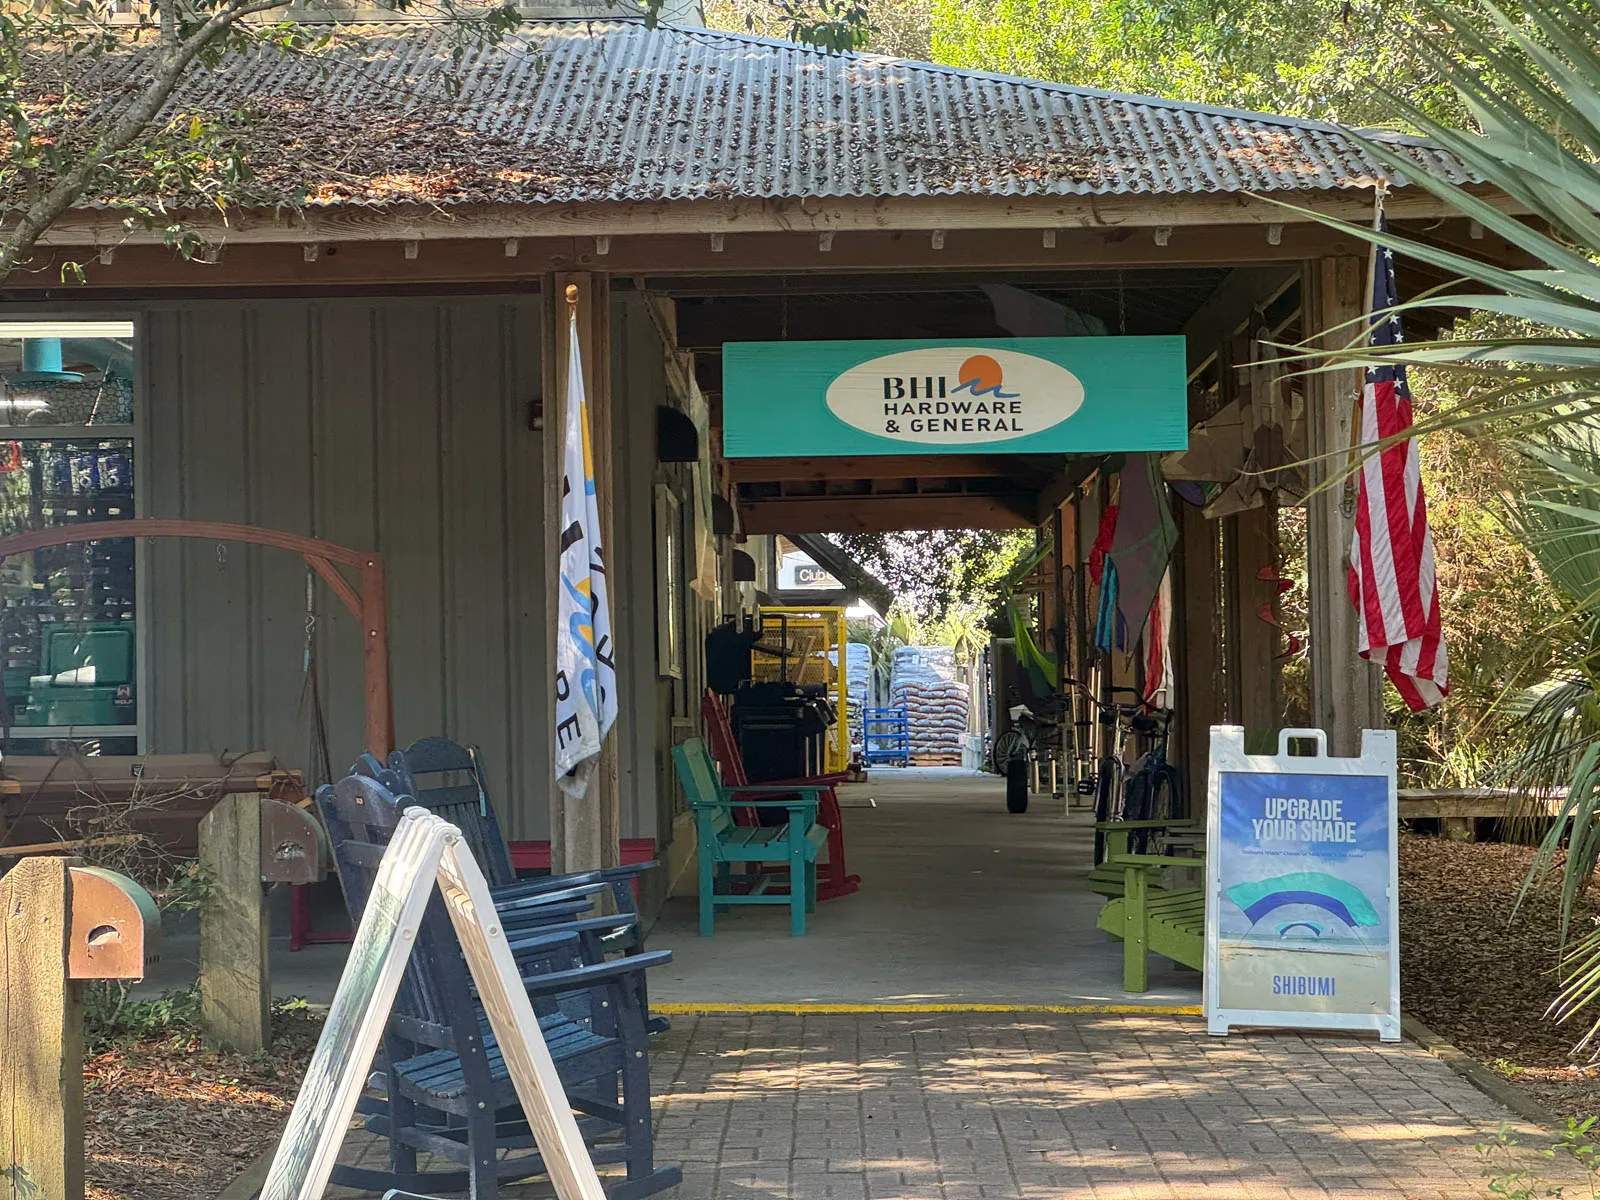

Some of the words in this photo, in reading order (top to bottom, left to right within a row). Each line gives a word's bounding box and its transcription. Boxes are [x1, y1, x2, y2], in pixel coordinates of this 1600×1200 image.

[883, 376, 946, 399] BHI
[884, 401, 1022, 415] HARDWARE
[885, 419, 901, 433] &
[910, 418, 1024, 432] GENERAL
[1265, 797, 1343, 821] UPGRADE
[1251, 818, 1297, 841] YOUR
[1300, 820, 1357, 843] SHADE
[1272, 975, 1335, 996] SHIBUMI
